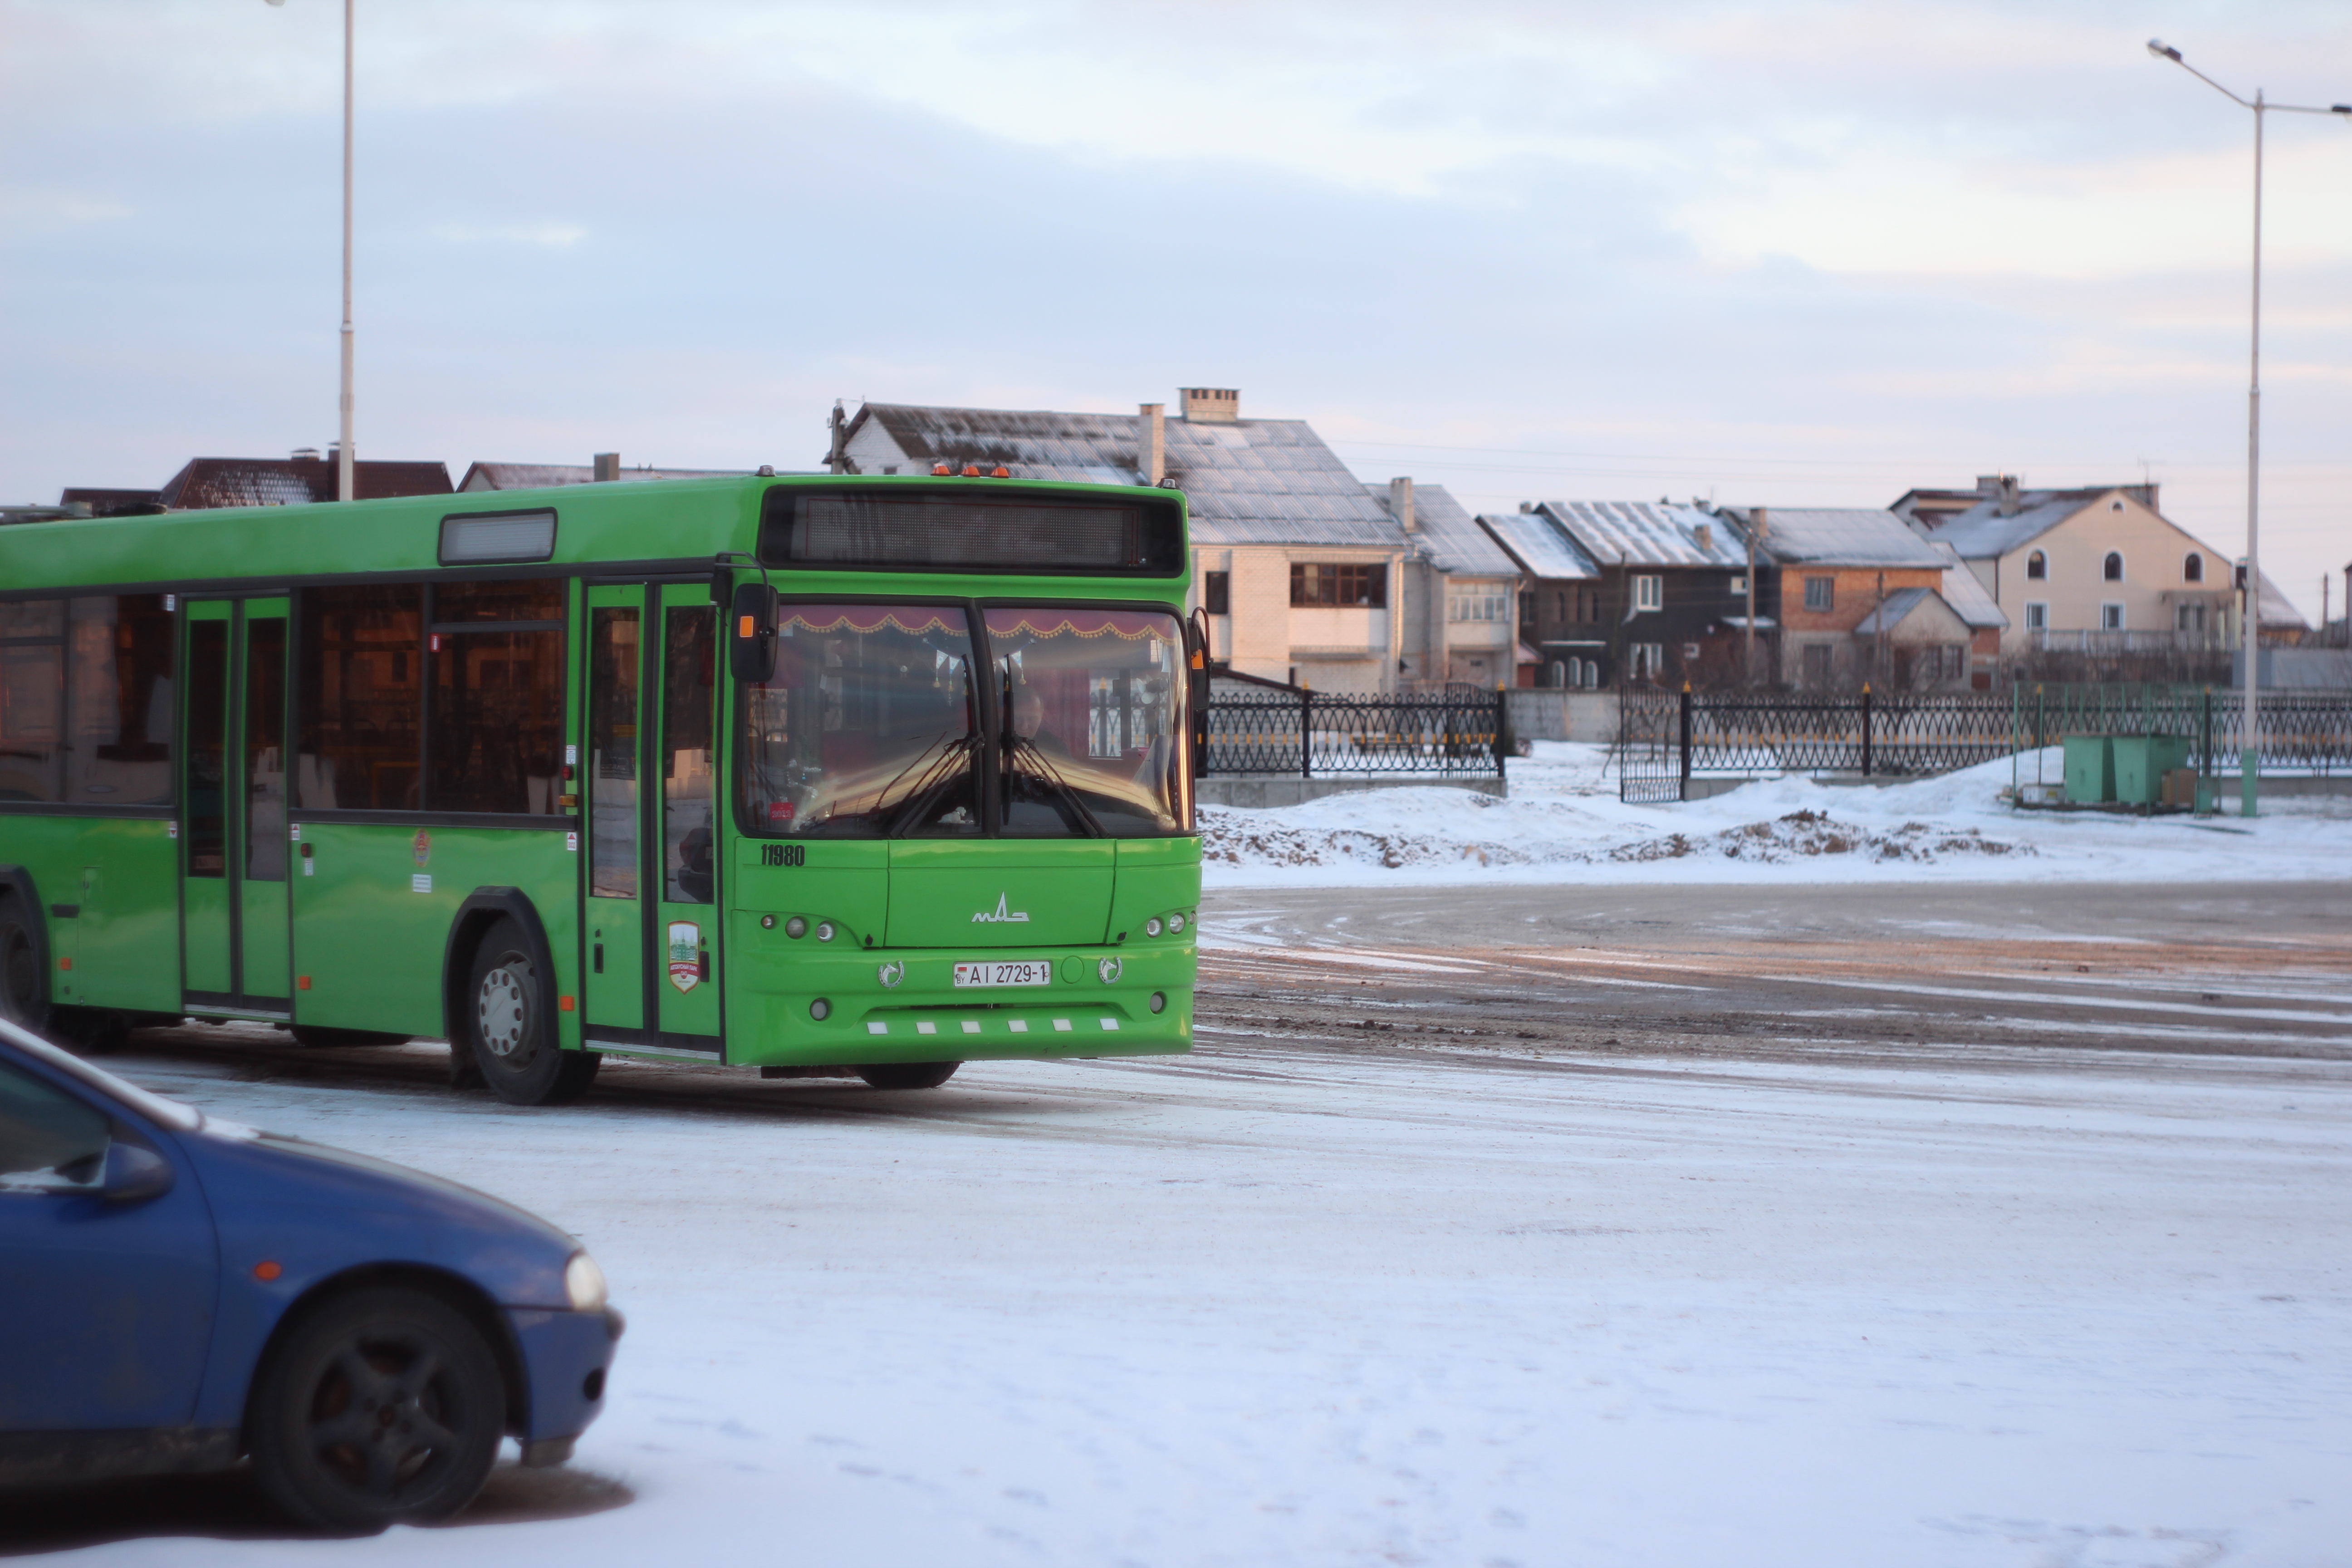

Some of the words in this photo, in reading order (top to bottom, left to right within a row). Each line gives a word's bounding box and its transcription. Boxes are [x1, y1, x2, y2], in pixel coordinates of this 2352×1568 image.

[761, 844, 805, 866] 11980
[970, 965, 989, 984] AI
[996, 965, 1045, 983] 2729-1
